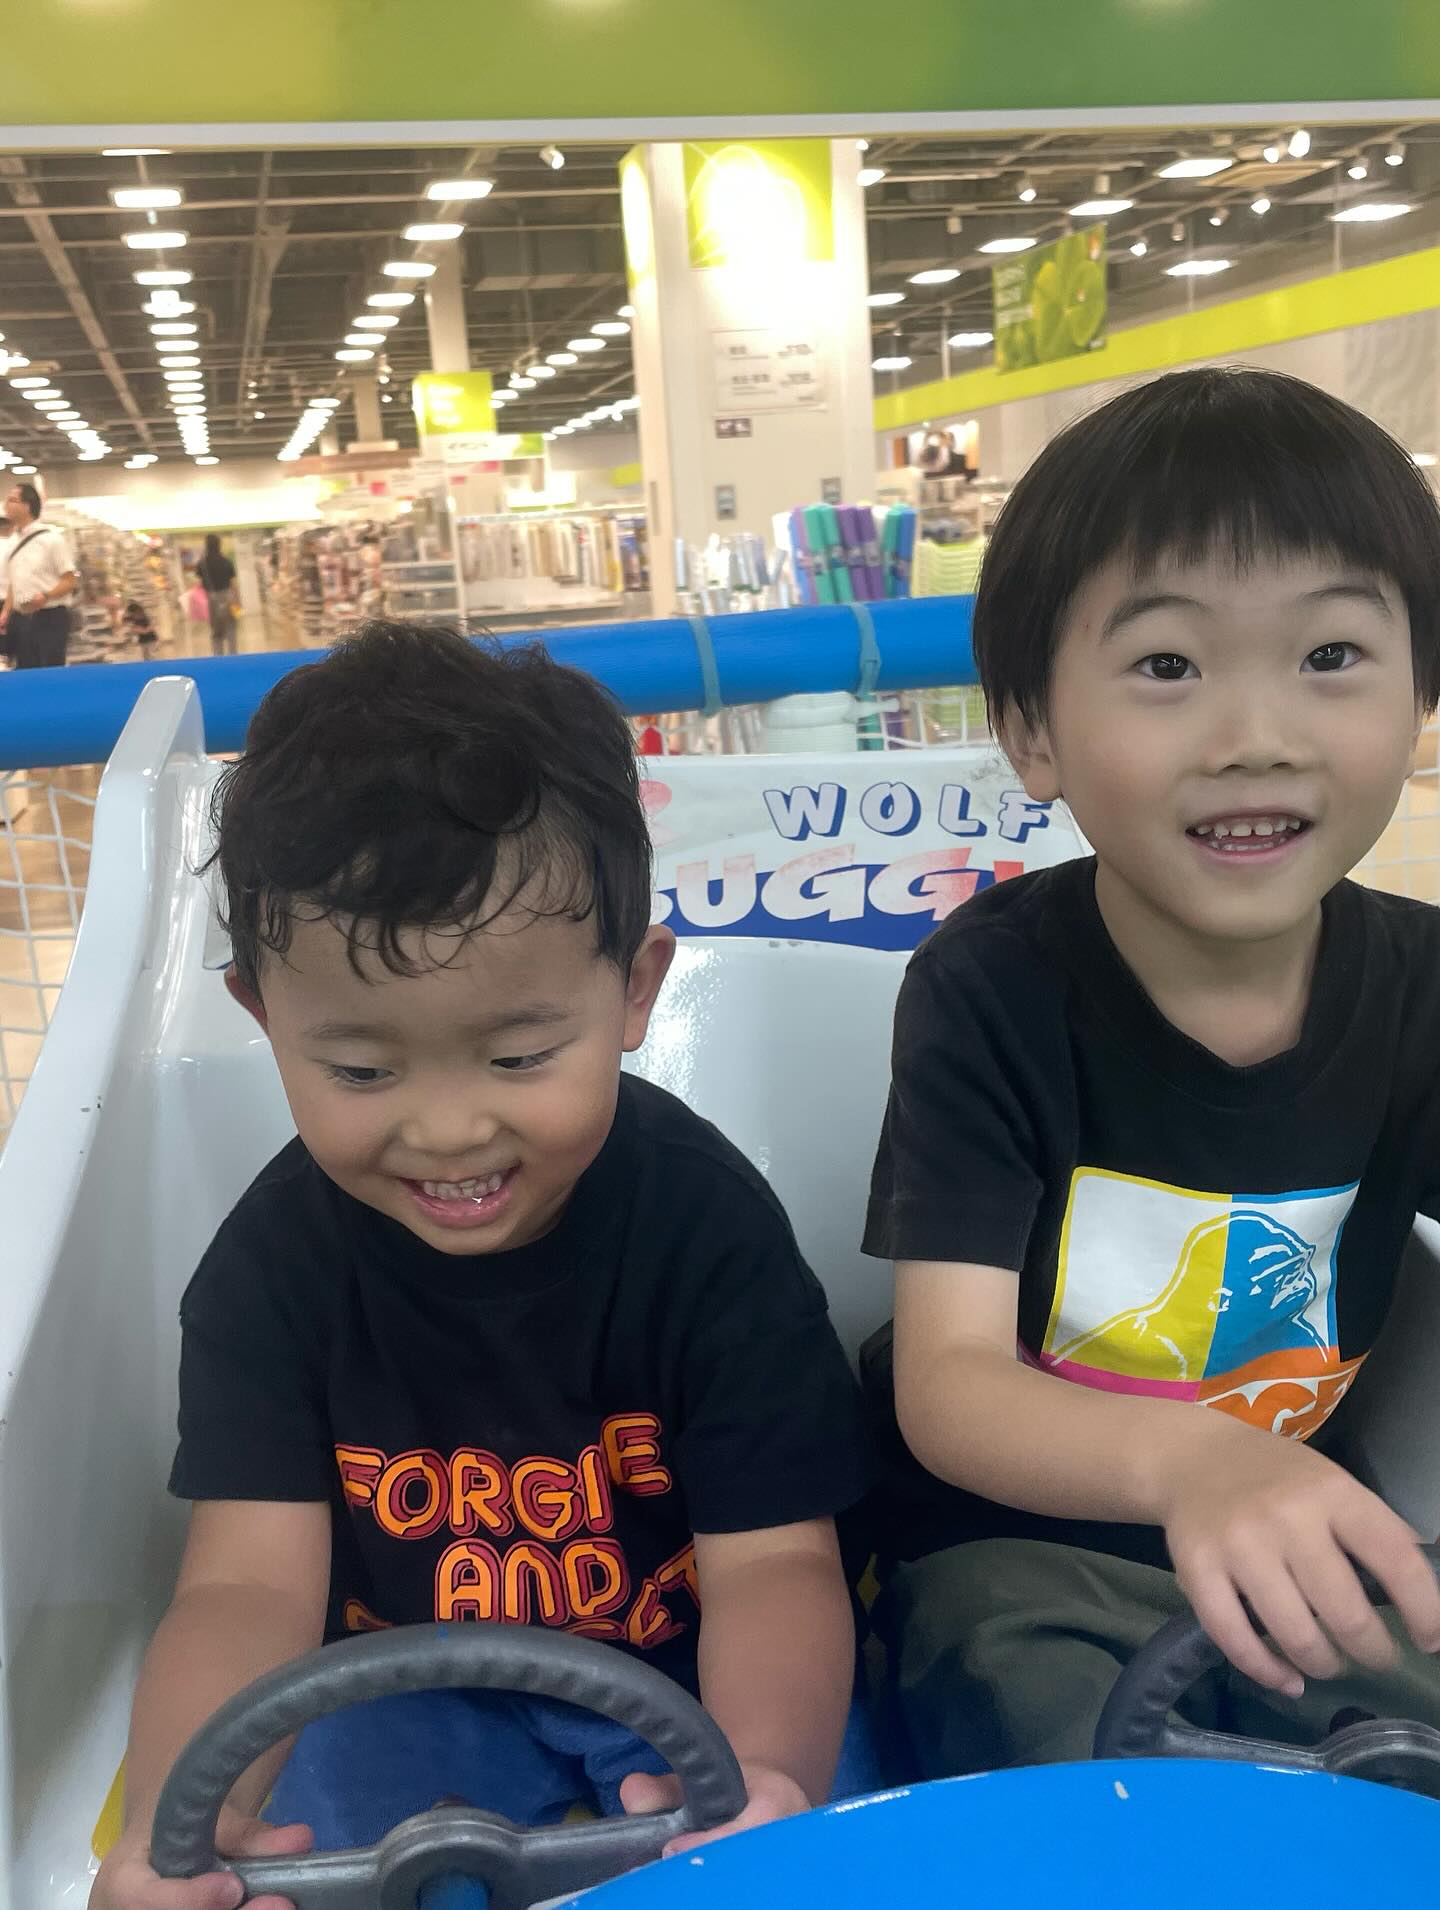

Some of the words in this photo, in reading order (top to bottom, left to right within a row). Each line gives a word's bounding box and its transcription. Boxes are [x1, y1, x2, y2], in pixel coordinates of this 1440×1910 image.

[763, 781, 1053, 843] WOLF
[651, 843, 1024, 928] UGG
[434, 1538, 630, 1627] AND
